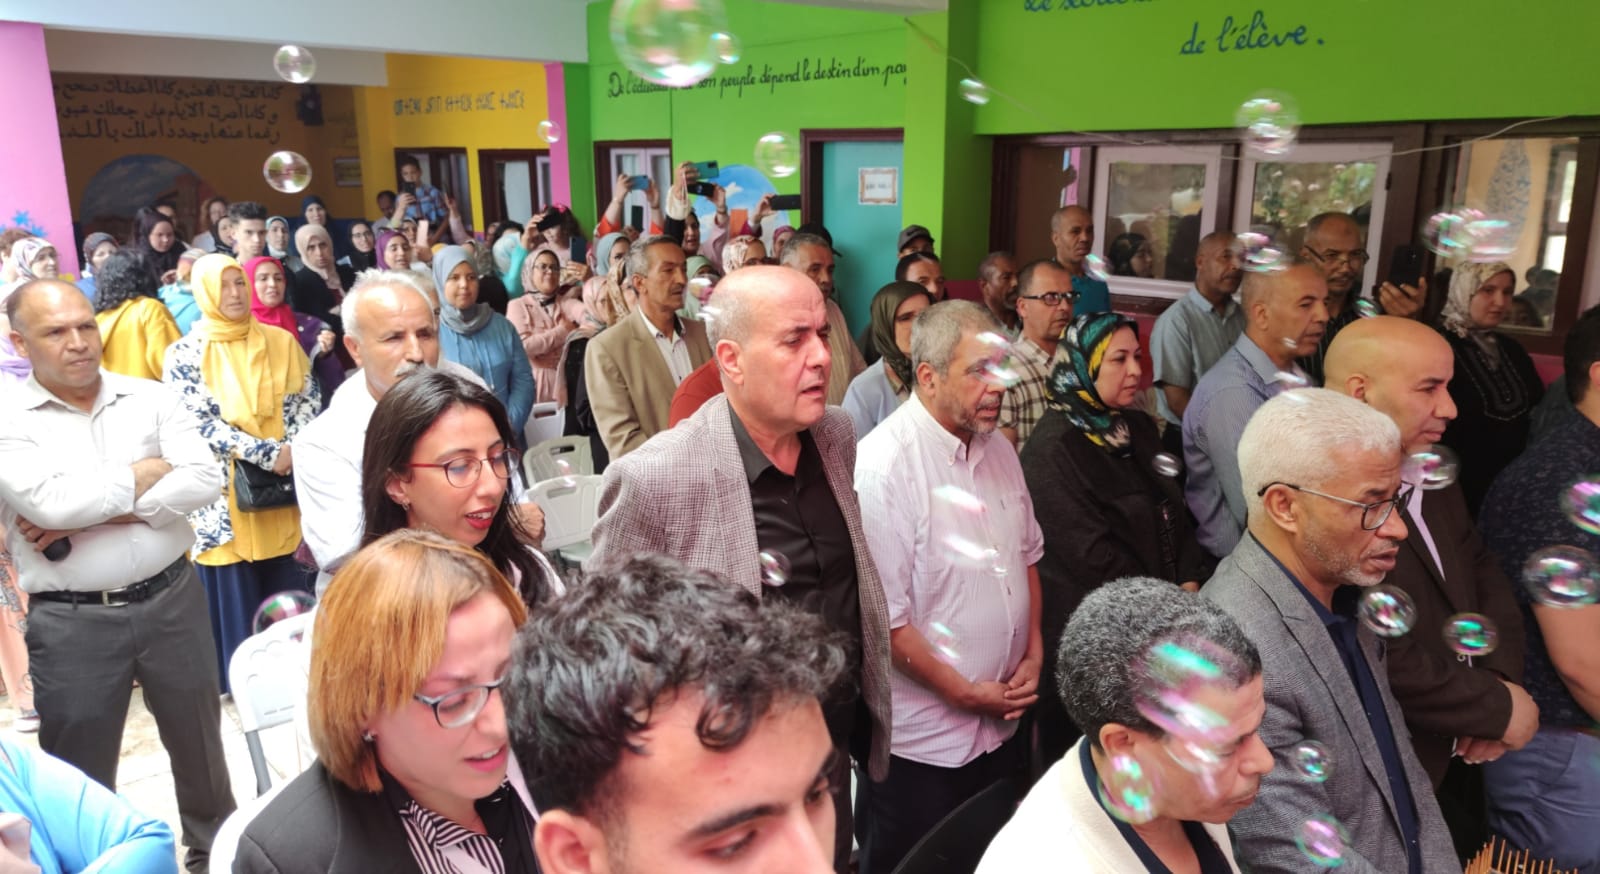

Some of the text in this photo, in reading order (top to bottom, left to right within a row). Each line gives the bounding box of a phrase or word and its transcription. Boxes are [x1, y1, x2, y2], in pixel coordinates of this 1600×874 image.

[1179, 21, 1206, 55] de
[608, 70, 624, 98] De
[720, 63, 756, 99] peuple
[759, 60, 800, 95] dépend
[802, 56, 811, 81] le
[813, 55, 851, 81] destin
[881, 63, 908, 87] pa
